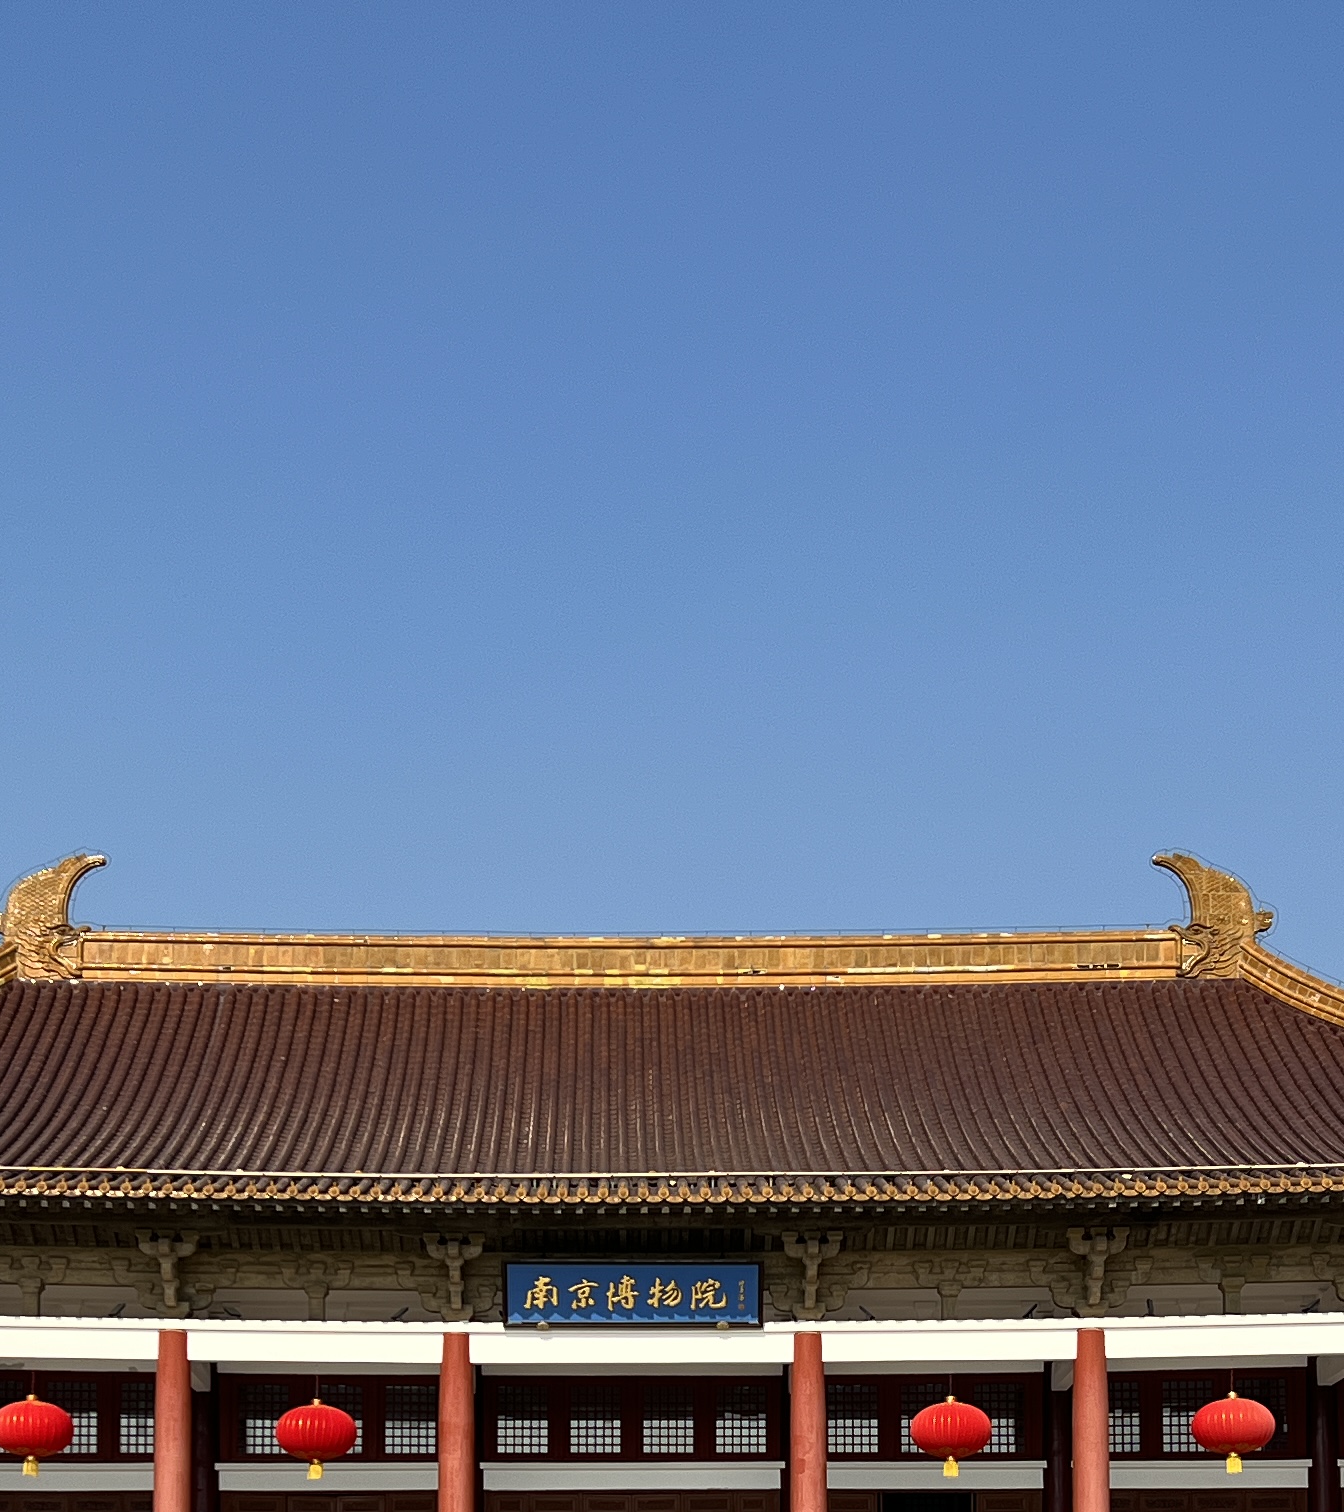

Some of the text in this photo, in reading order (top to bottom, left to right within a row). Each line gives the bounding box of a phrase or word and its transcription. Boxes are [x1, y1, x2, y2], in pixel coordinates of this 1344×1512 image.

[523, 1275, 727, 1311] 南京博物院
